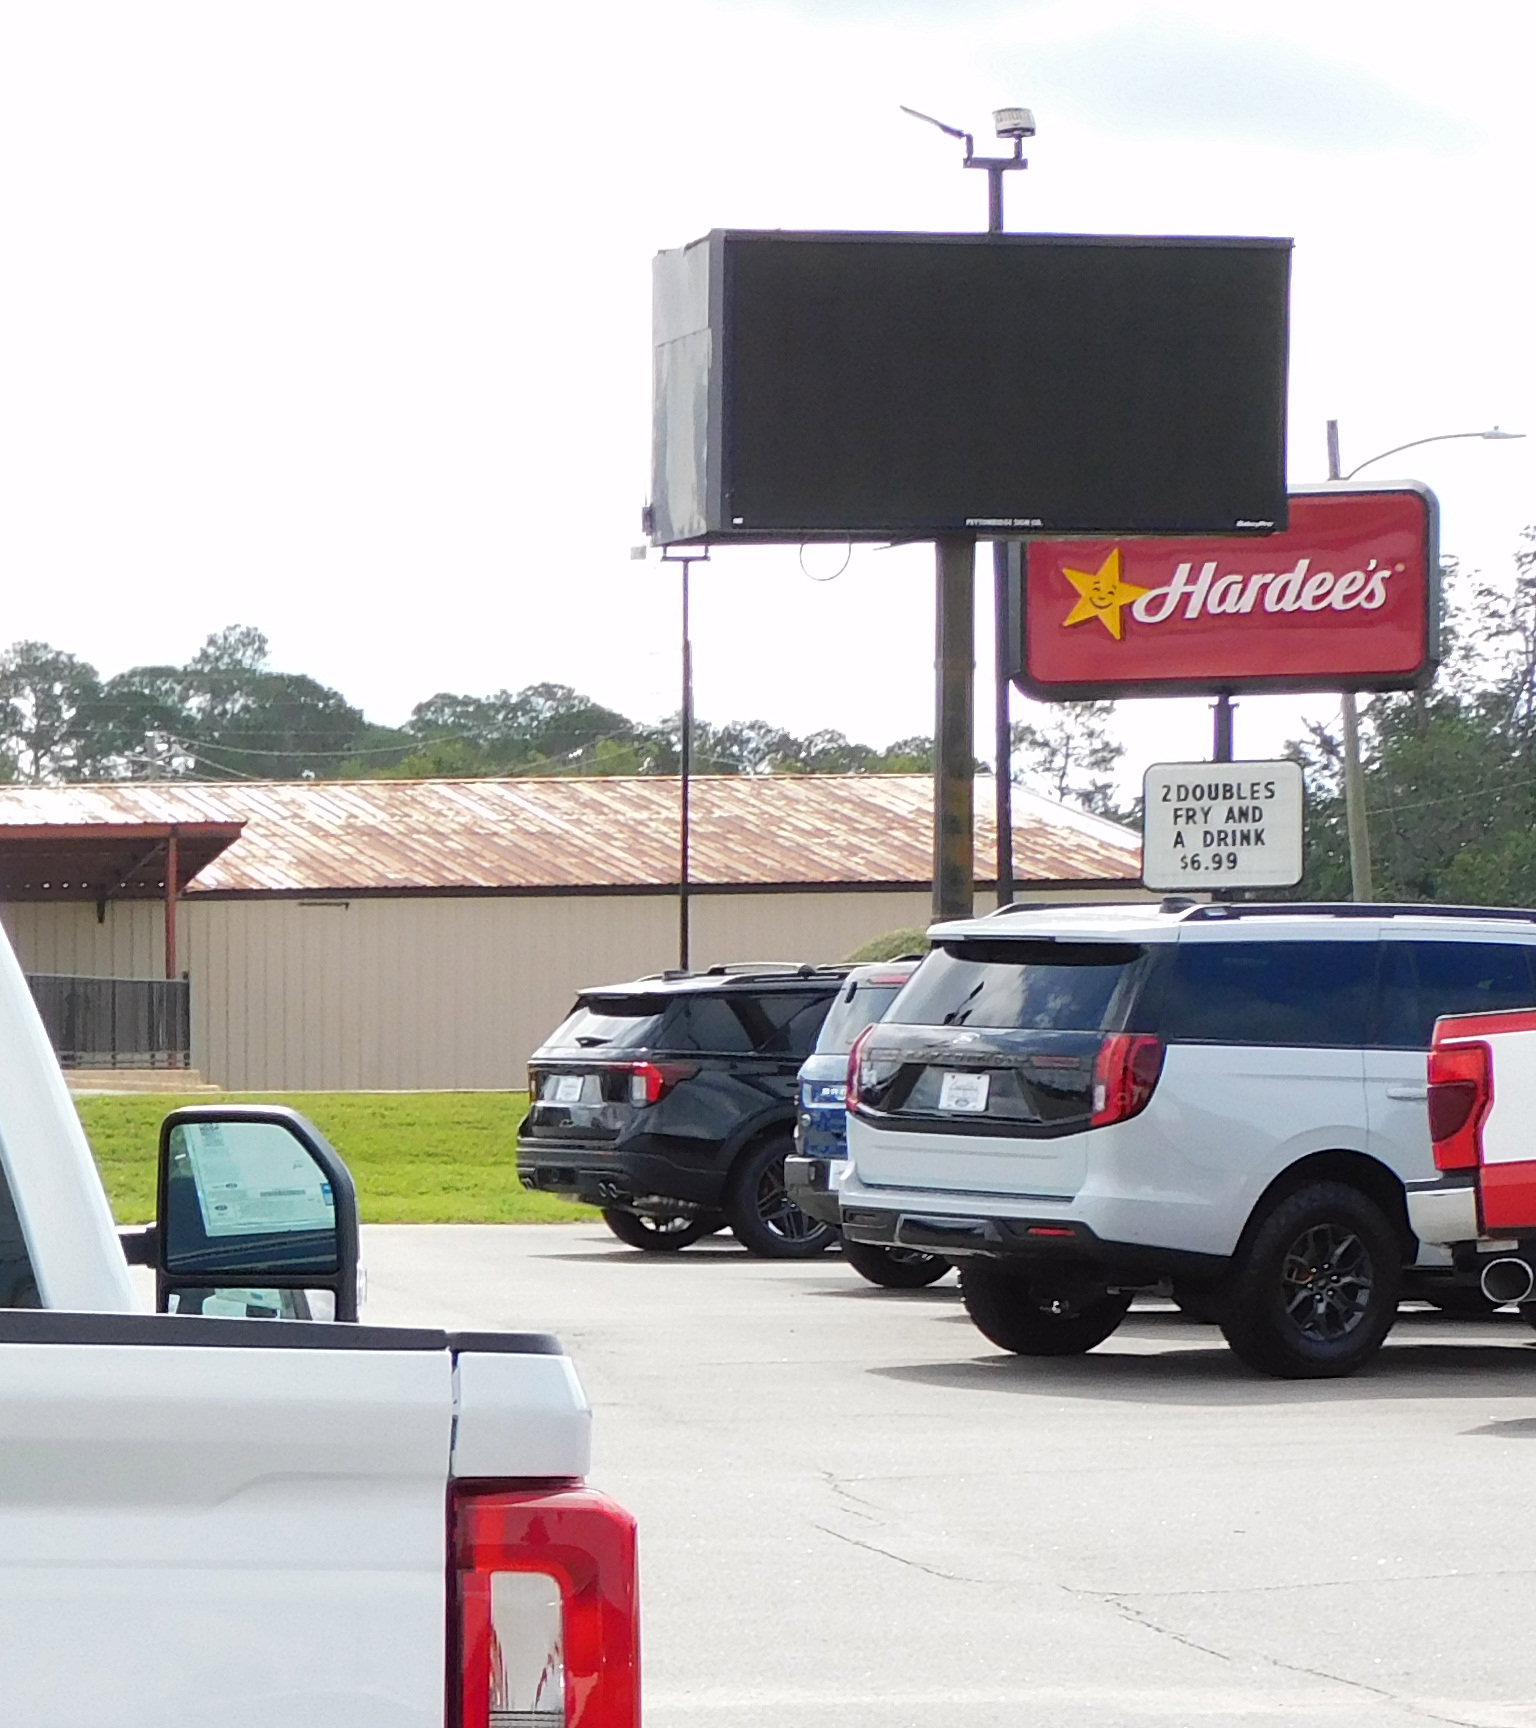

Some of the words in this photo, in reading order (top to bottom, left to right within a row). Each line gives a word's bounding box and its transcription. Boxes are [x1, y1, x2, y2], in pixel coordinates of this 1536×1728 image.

[1131, 558, 1392, 624] Hardee's
[1173, 806, 1212, 826] FRY
[1224, 805, 1264, 824] AND
[1173, 830, 1185, 848] A
[1203, 828, 1266, 848] DRINK
[1180, 852, 1238, 871] $6.99
